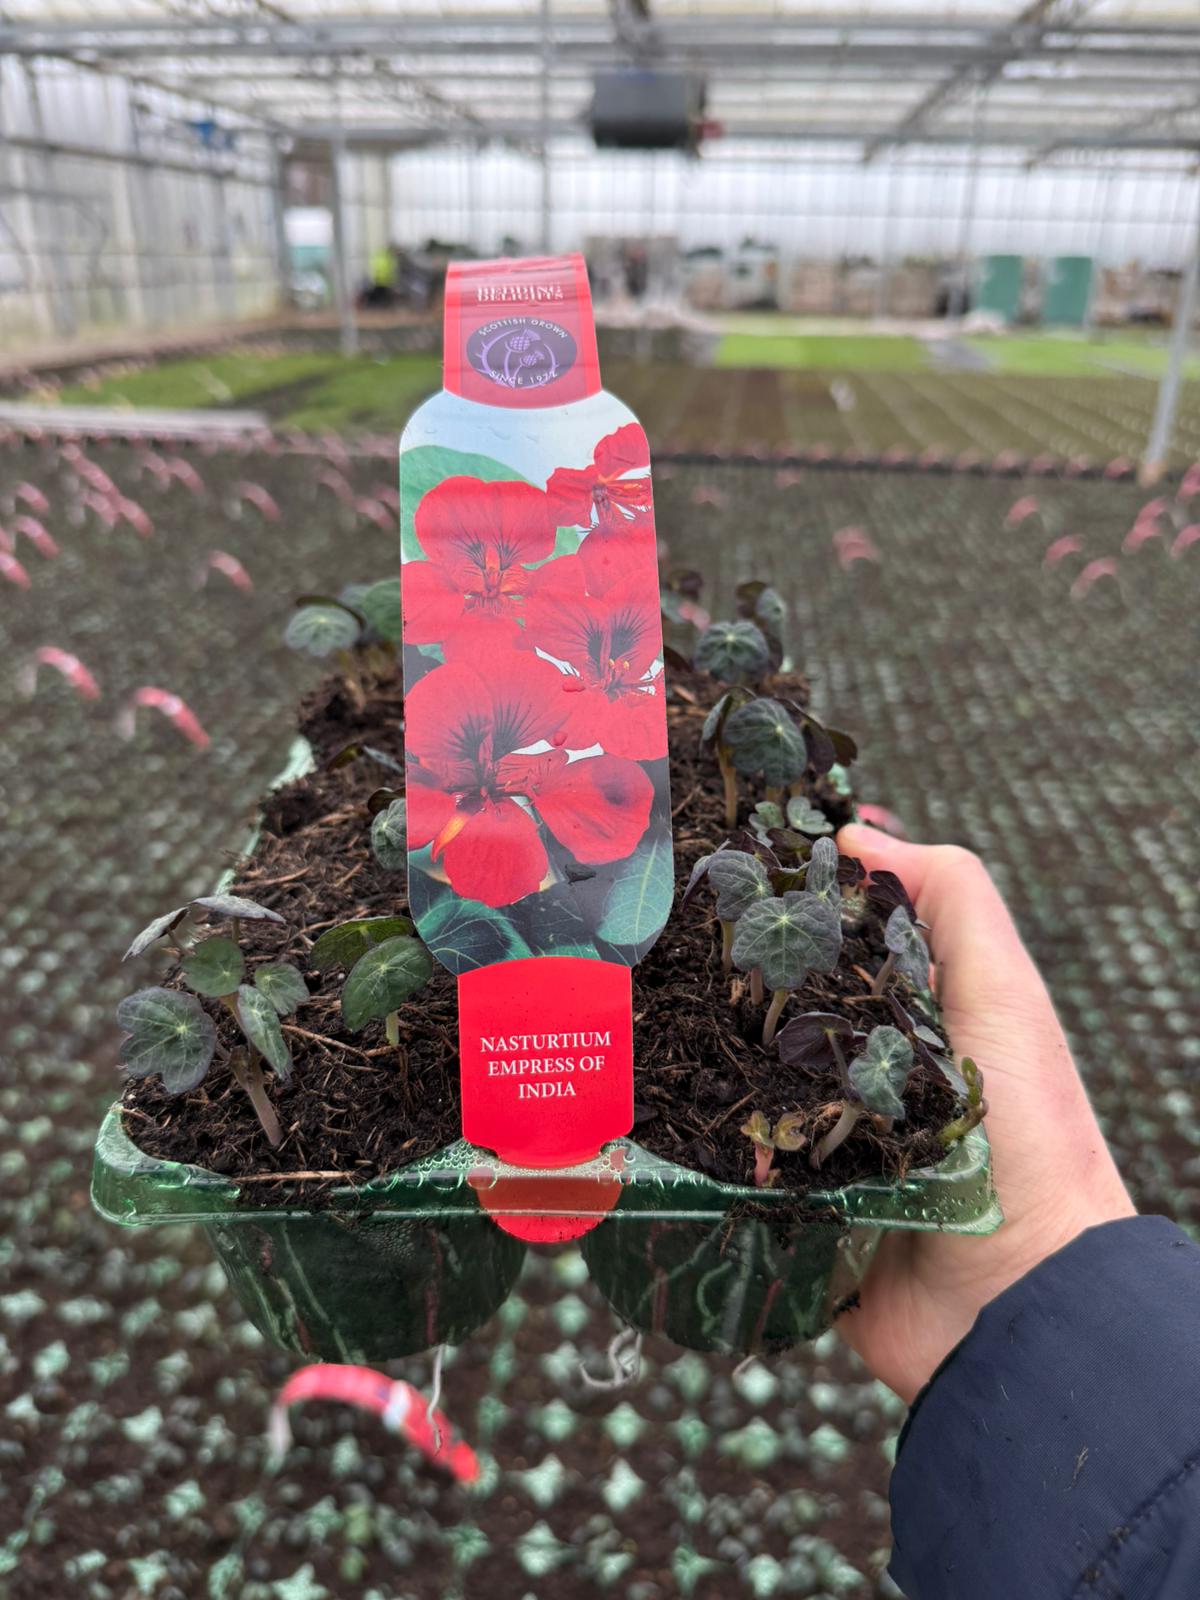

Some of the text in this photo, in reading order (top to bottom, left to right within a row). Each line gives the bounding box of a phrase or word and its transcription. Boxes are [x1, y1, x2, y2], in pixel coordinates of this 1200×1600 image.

[479, 318, 568, 339] SCOTTISH GROWN
[489, 370, 523, 385] SINCE
[480, 1031, 611, 1052] NASTURTIUM
[488, 1055, 605, 1076] EMPRESS OF
[518, 1081, 576, 1099] INDIA
